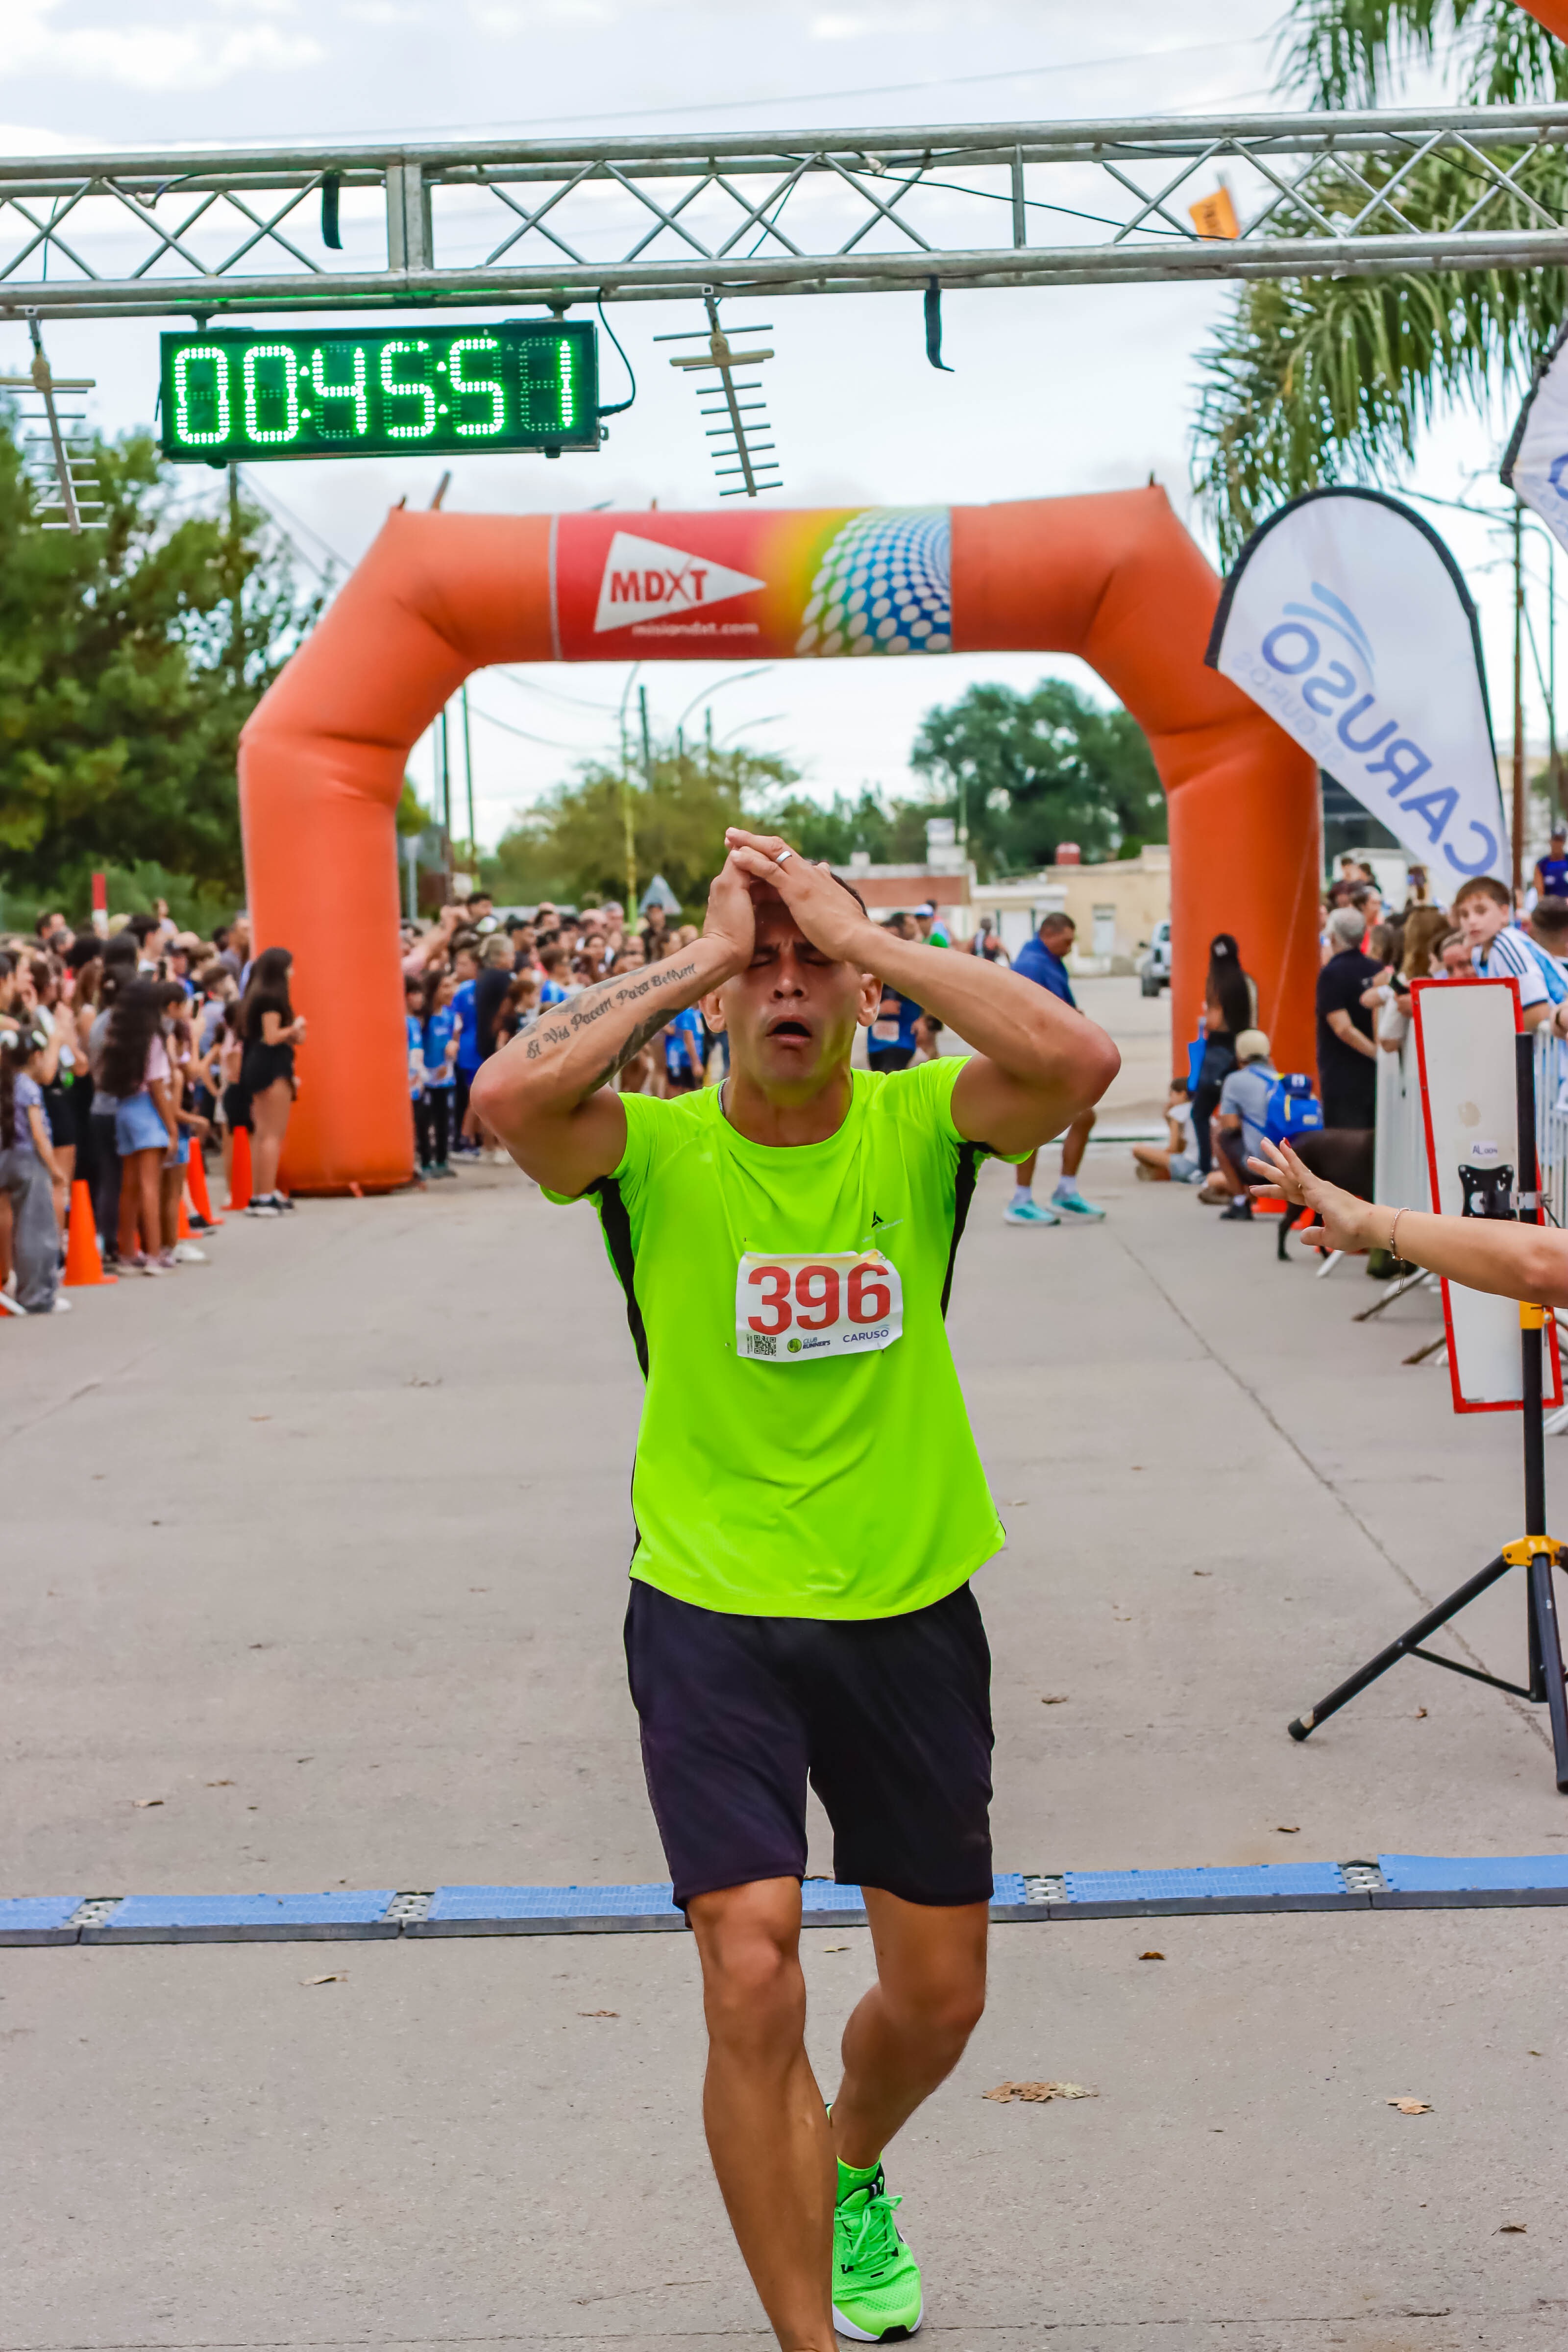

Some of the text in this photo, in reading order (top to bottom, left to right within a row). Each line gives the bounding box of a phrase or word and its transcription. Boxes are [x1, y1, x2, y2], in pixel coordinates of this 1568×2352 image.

[611, 570, 708, 603] MDXT
[543, 1026, 570, 1044] Vis
[570, 998, 615, 1031] Pacem
[616, 980, 651, 1005] Para
[748, 1262, 890, 1335] 396
[843, 1329, 888, 1342] CARUSO
